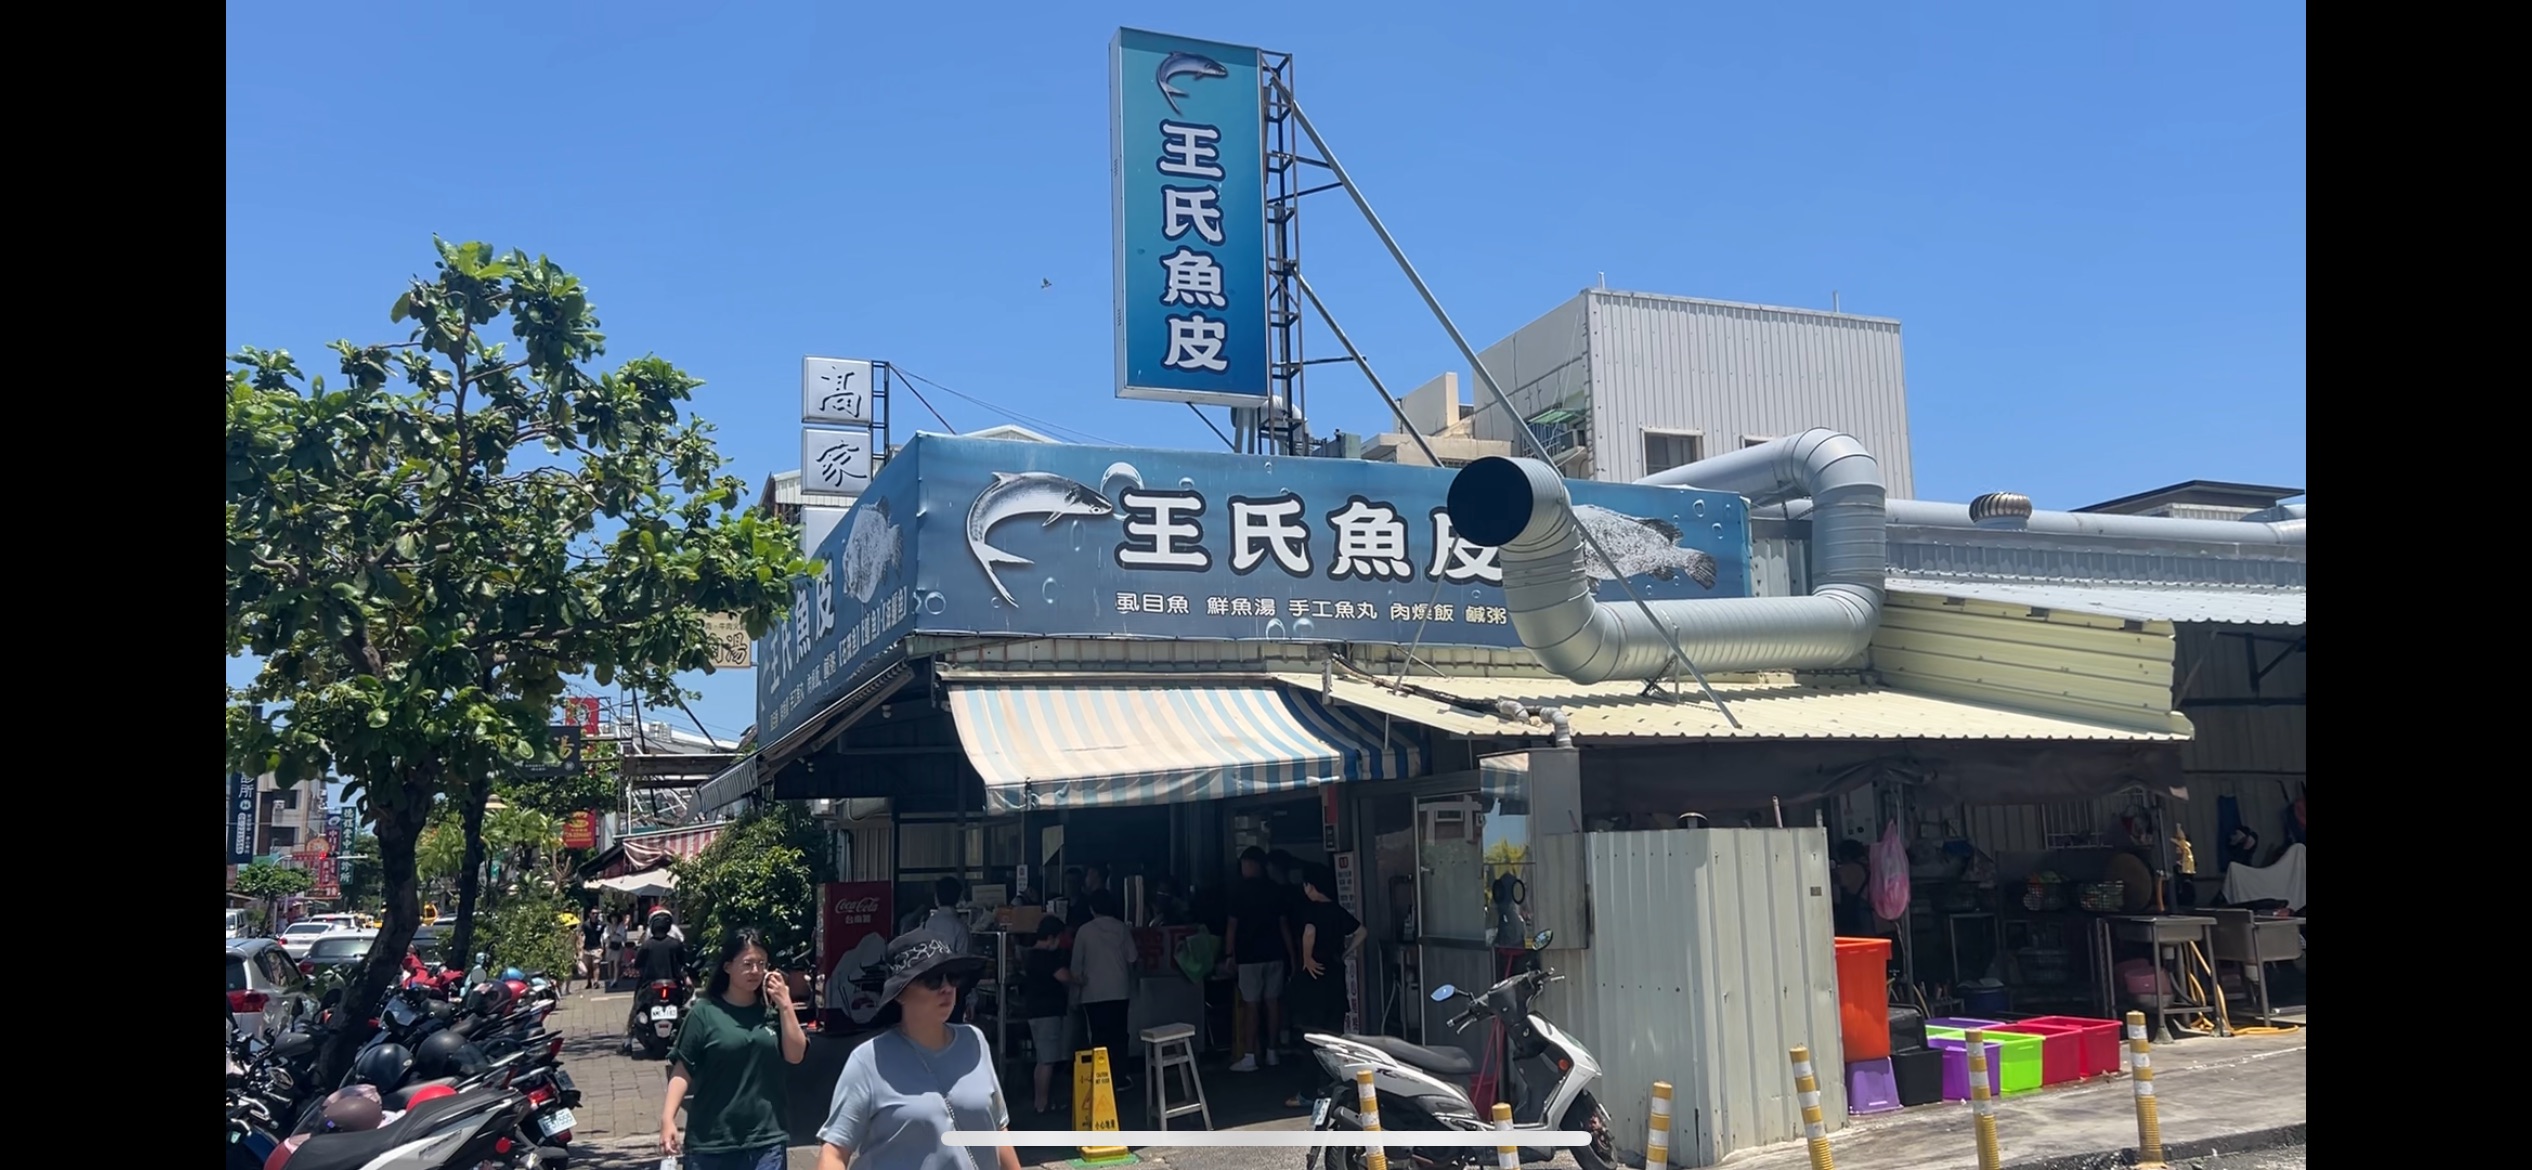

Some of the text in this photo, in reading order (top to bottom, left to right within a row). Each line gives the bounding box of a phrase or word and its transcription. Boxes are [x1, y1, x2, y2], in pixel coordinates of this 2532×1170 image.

[1157, 120, 1229, 373] 王氏魚皮
[816, 366, 868, 487] 高家
[1117, 492, 1503, 582] 王氏魚皮
[770, 558, 836, 695] 王氏魚皮
[1116, 592, 1507, 625] 虱目魚 鮮魚湯 手工魚丸 肉燥飯 鹹粥
